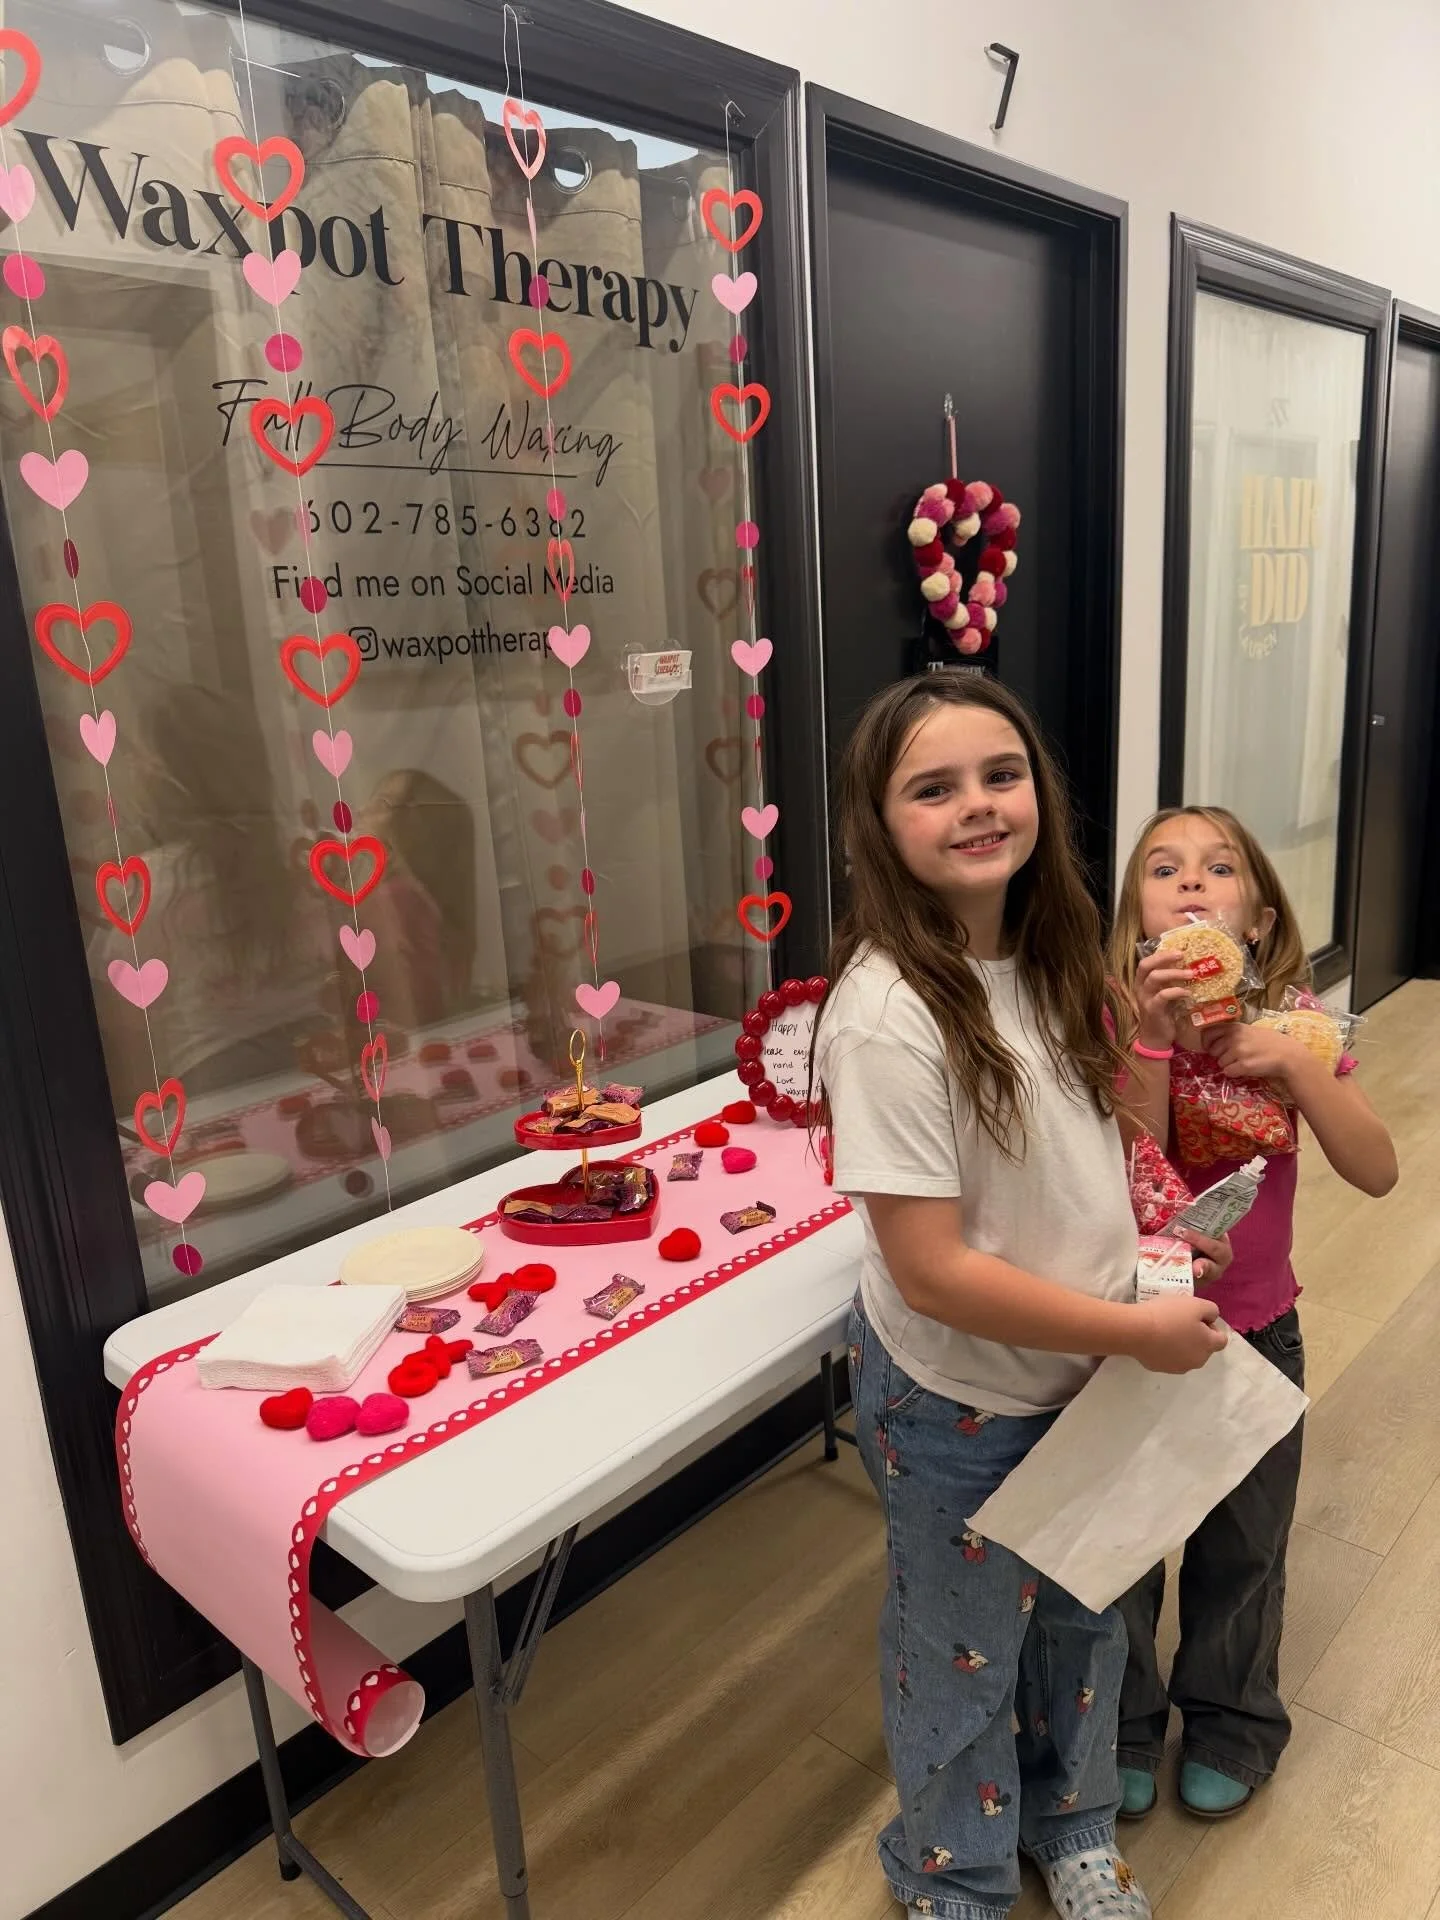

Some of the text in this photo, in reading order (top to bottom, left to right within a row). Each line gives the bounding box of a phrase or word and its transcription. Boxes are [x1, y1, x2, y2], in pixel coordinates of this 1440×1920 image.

[14, 128, 700, 353] Waxpot Therapy
[325, 383, 464, 475] Body
[481, 399, 624, 487] Waxing
[272, 562, 615, 599] Fid me on Social Media
[771, 1020, 798, 1036] Happy
[776, 1076, 797, 1085] Love
